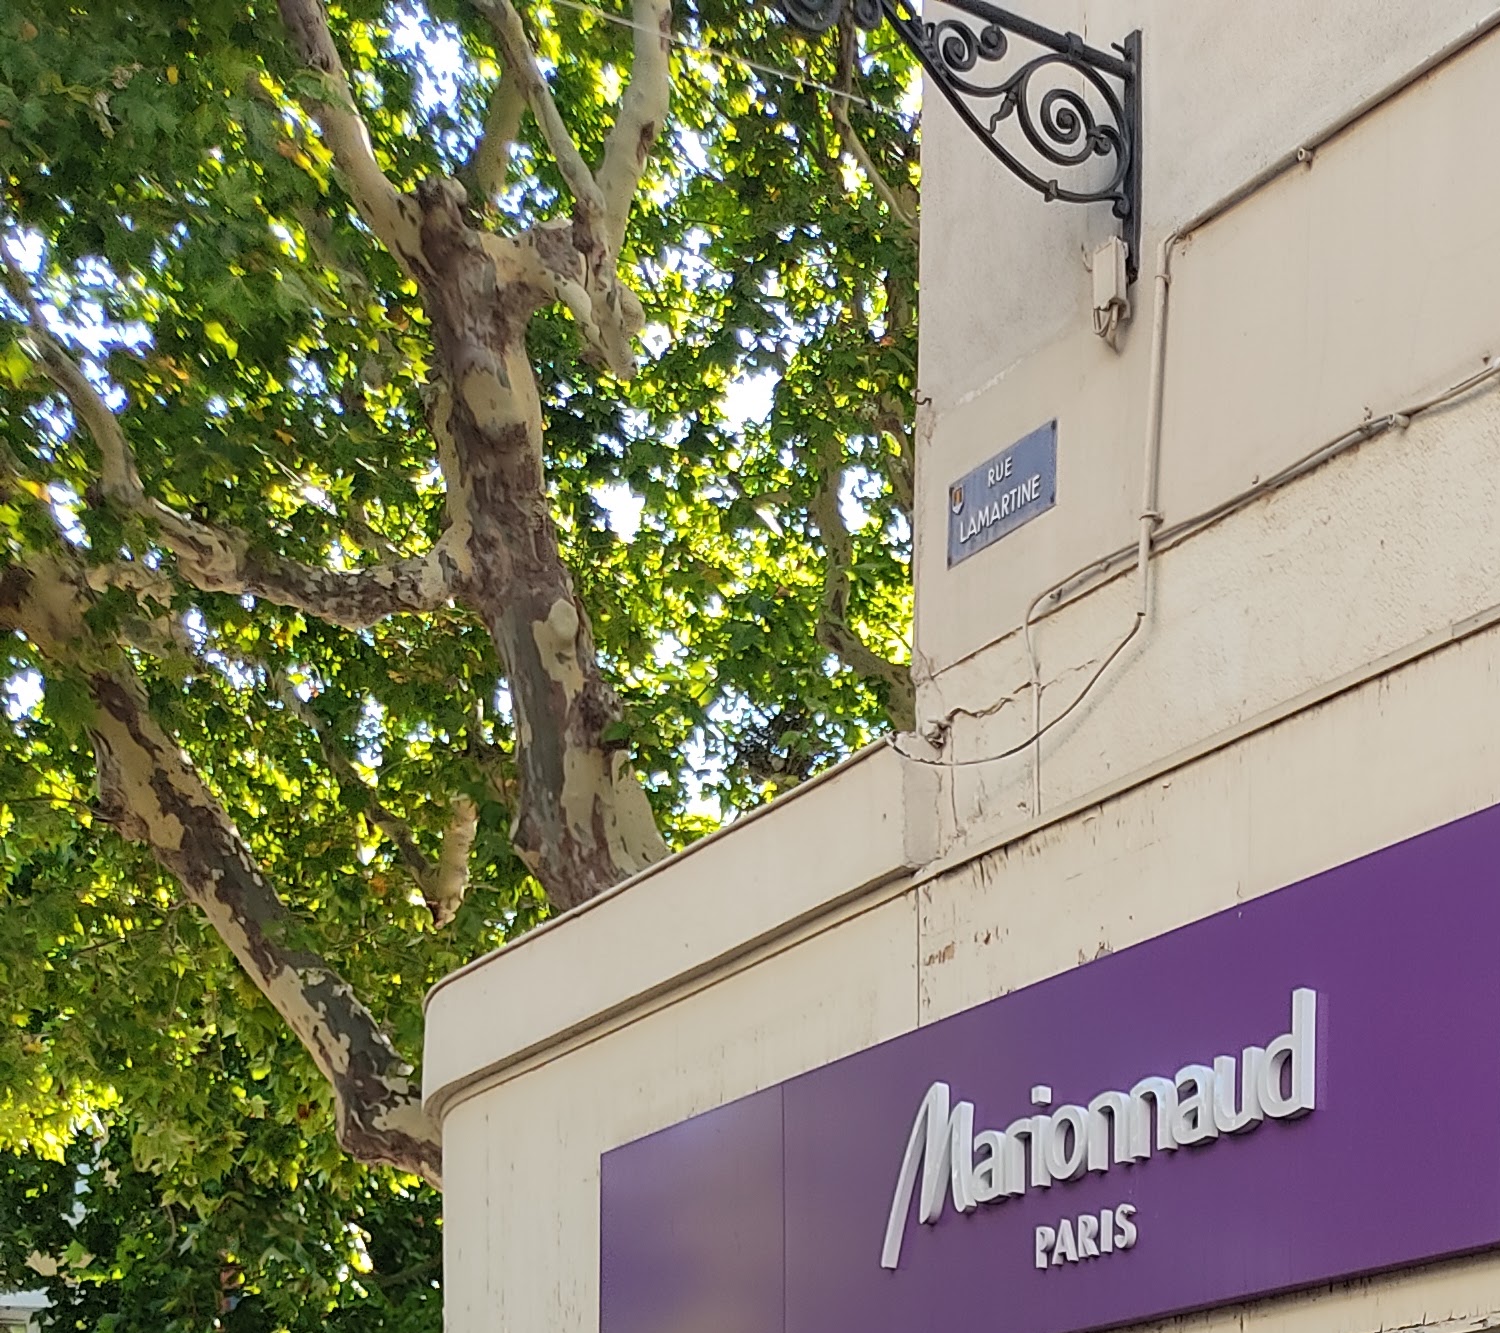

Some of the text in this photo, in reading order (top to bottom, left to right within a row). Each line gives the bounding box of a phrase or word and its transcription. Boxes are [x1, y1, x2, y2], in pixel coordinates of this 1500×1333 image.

[987, 456, 1013, 488] RUE
[959, 474, 1041, 543] LAMARTINE
[881, 987, 1317, 1269] Marionnaud
[1035, 1203, 1138, 1269] PARIS
